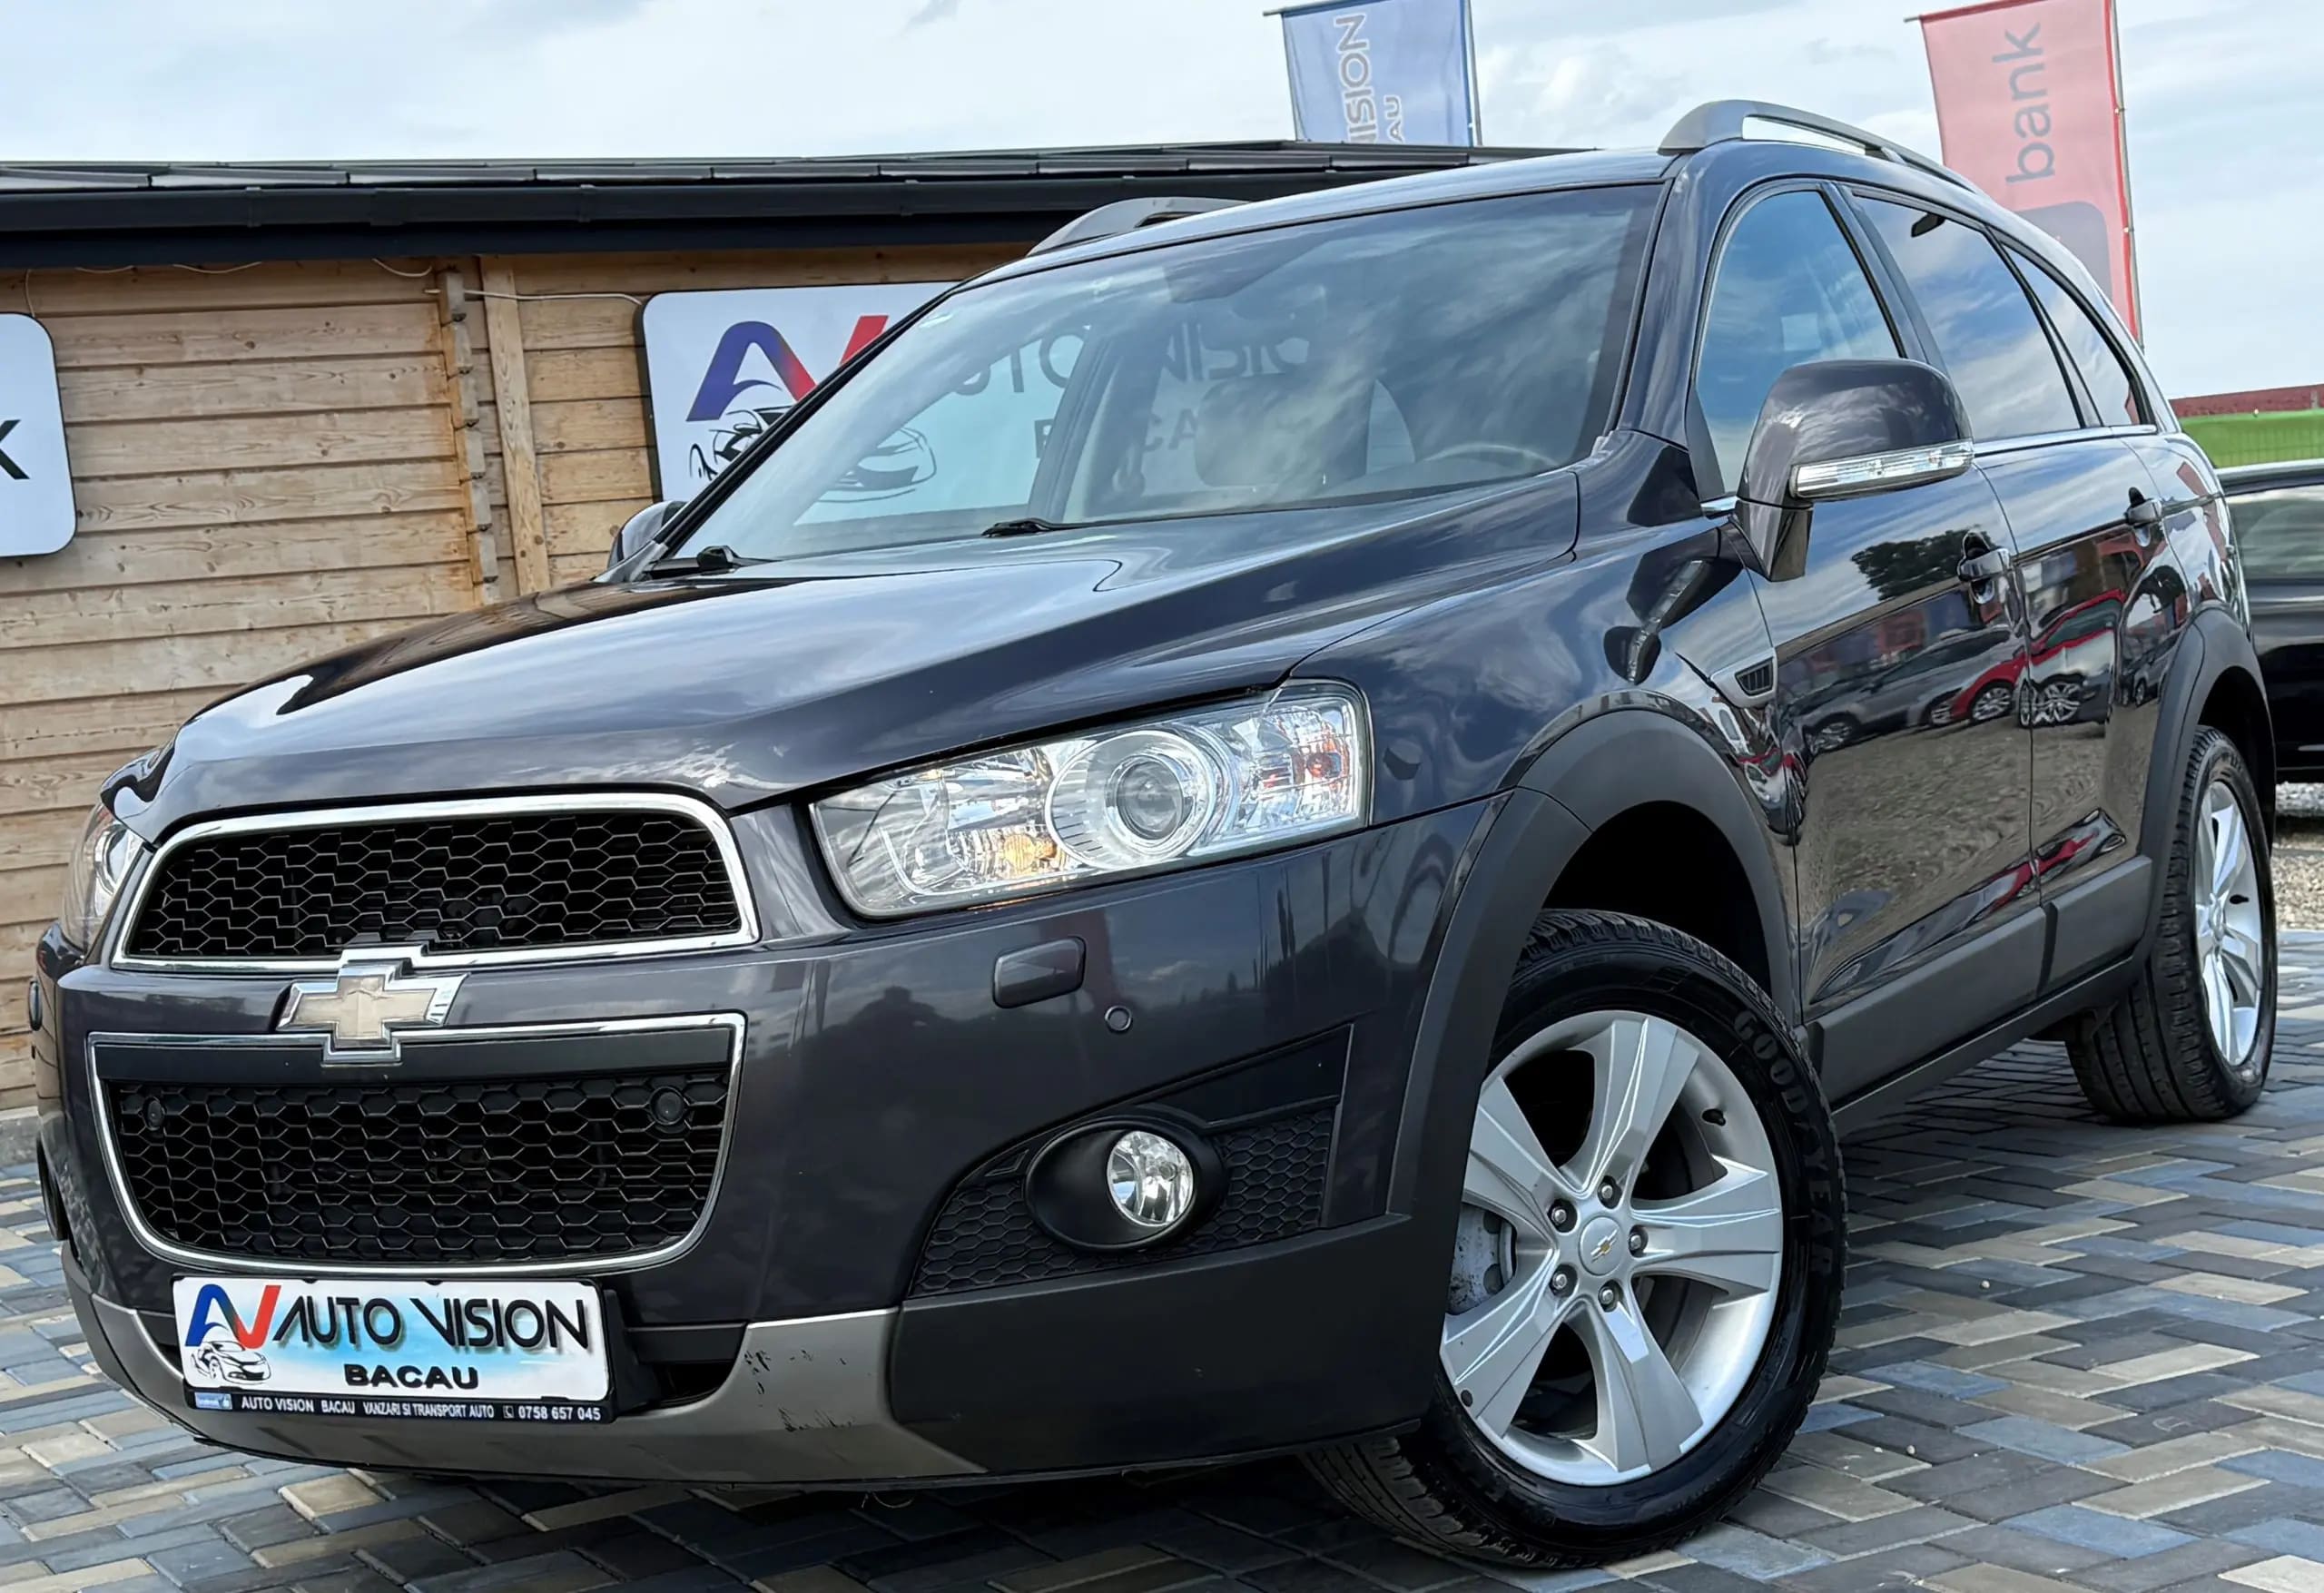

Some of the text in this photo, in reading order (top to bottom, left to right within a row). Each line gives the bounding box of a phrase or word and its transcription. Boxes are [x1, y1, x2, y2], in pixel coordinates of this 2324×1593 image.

[1992, 22, 2055, 184] bank
[272, 1295, 589, 1350] AUTO VISION
[343, 1363, 478, 1390] BACAU
[241, 1396, 272, 1411] AUTO
[274, 1398, 315, 1412] VISION
[321, 1400, 356, 1414] BACAU
[362, 1401, 401, 1415] VANZARI
[412, 1403, 467, 1417] TRANSPORT
[468, 1404, 495, 1418] AUTO
[517, 1405, 548, 1420] 0758
[551, 1407, 573, 1421] 657
[576, 1407, 601, 1421] 045
